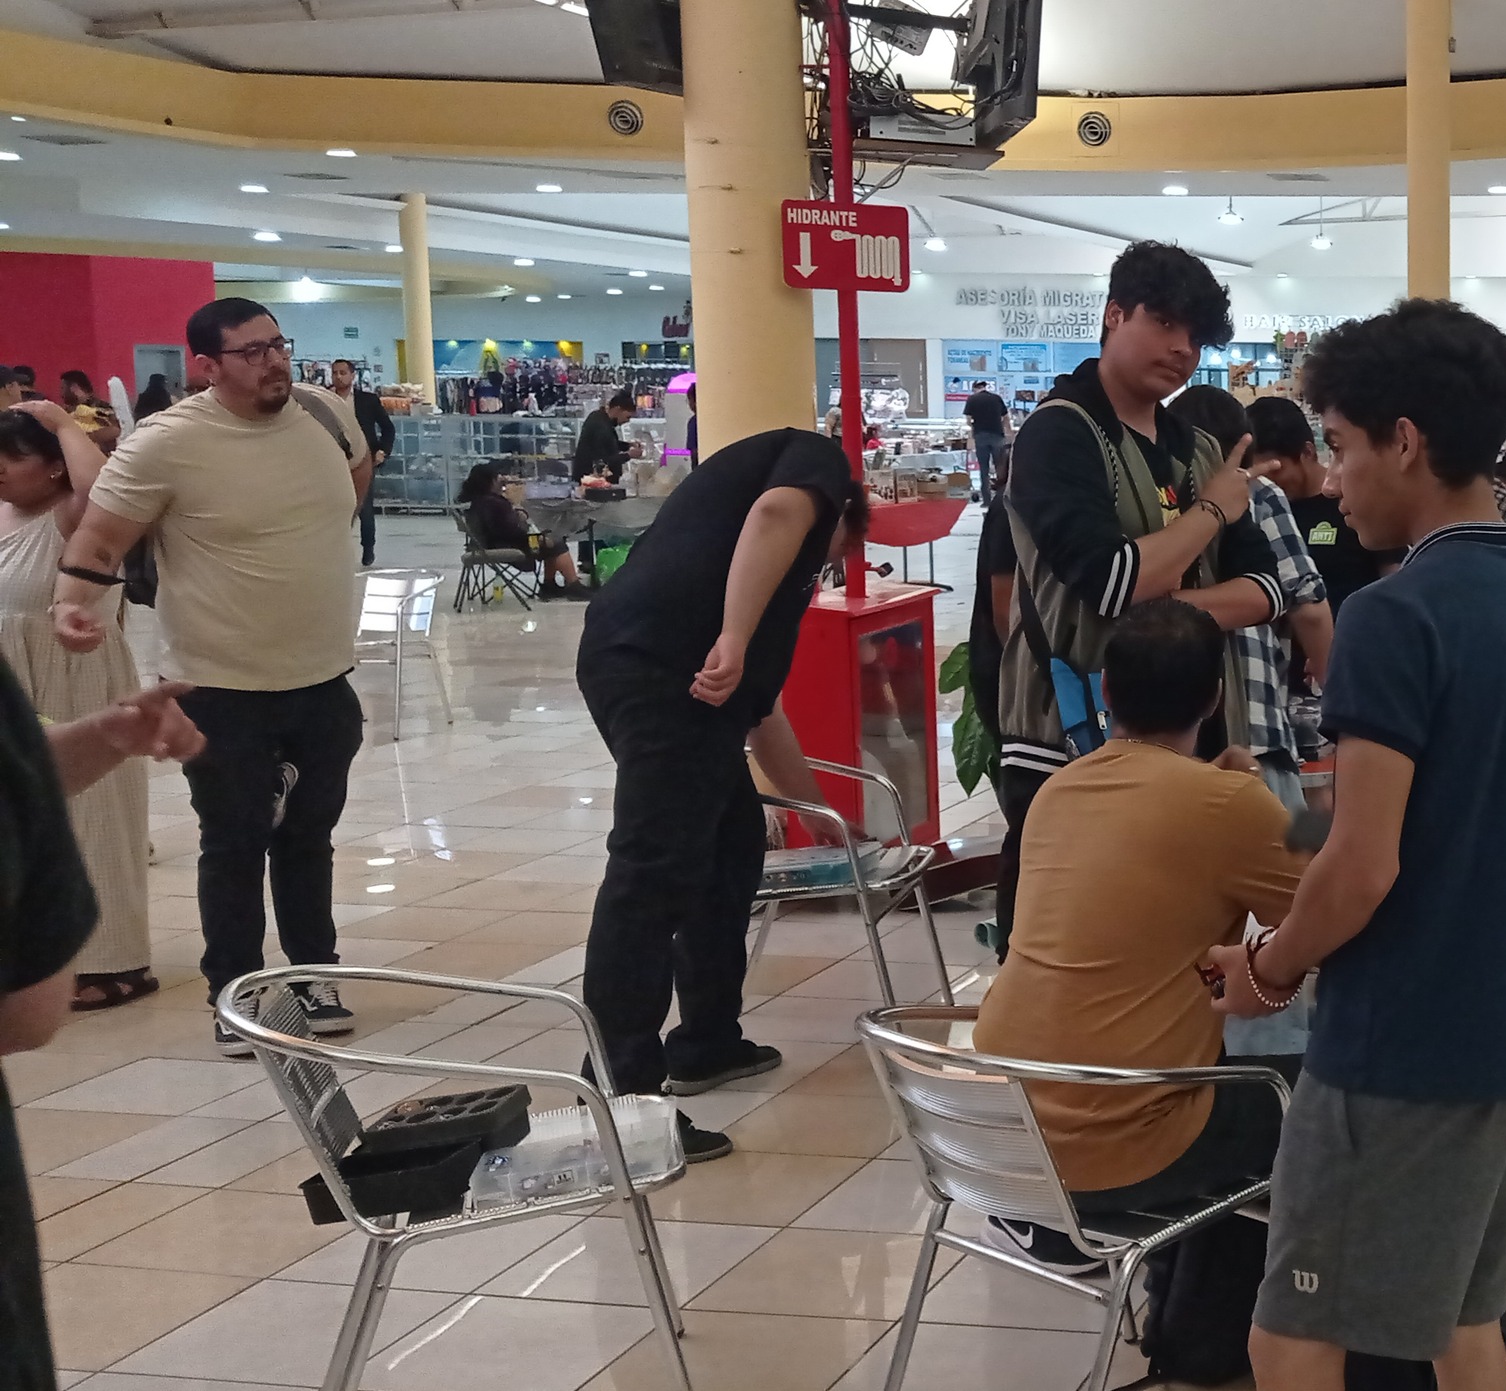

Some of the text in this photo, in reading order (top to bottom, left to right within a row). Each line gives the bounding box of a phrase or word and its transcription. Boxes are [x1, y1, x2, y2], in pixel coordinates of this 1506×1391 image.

[787, 207, 858, 227] HIDRANTE
[956, 287, 1108, 308] ASESORÍA MIGRAT
[1001, 308, 1100, 326] VISA LASER
[1004, 325, 1097, 338] TONY MAQUEDA
